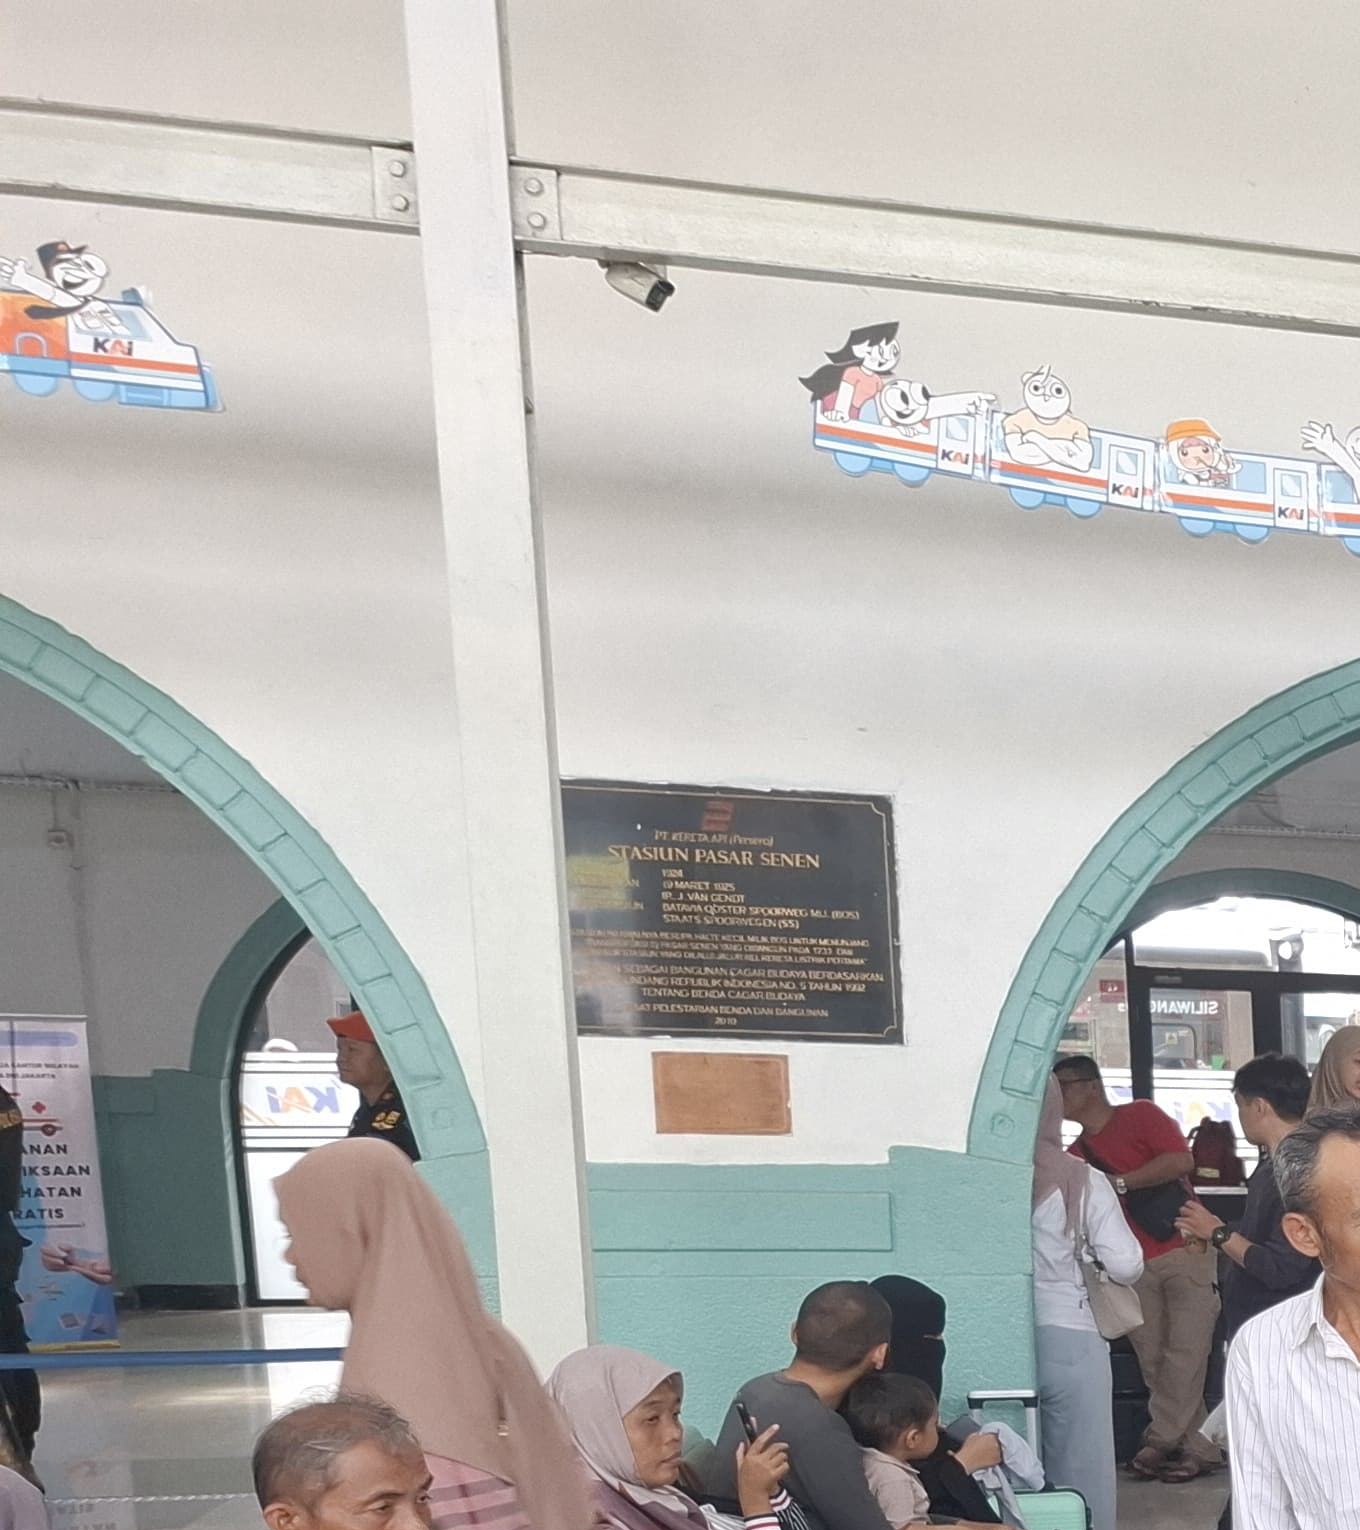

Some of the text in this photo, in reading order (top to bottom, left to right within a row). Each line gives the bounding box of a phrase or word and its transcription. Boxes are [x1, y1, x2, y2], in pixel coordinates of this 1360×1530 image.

[608, 845, 821, 869] STASIUN PASAR SENEN
